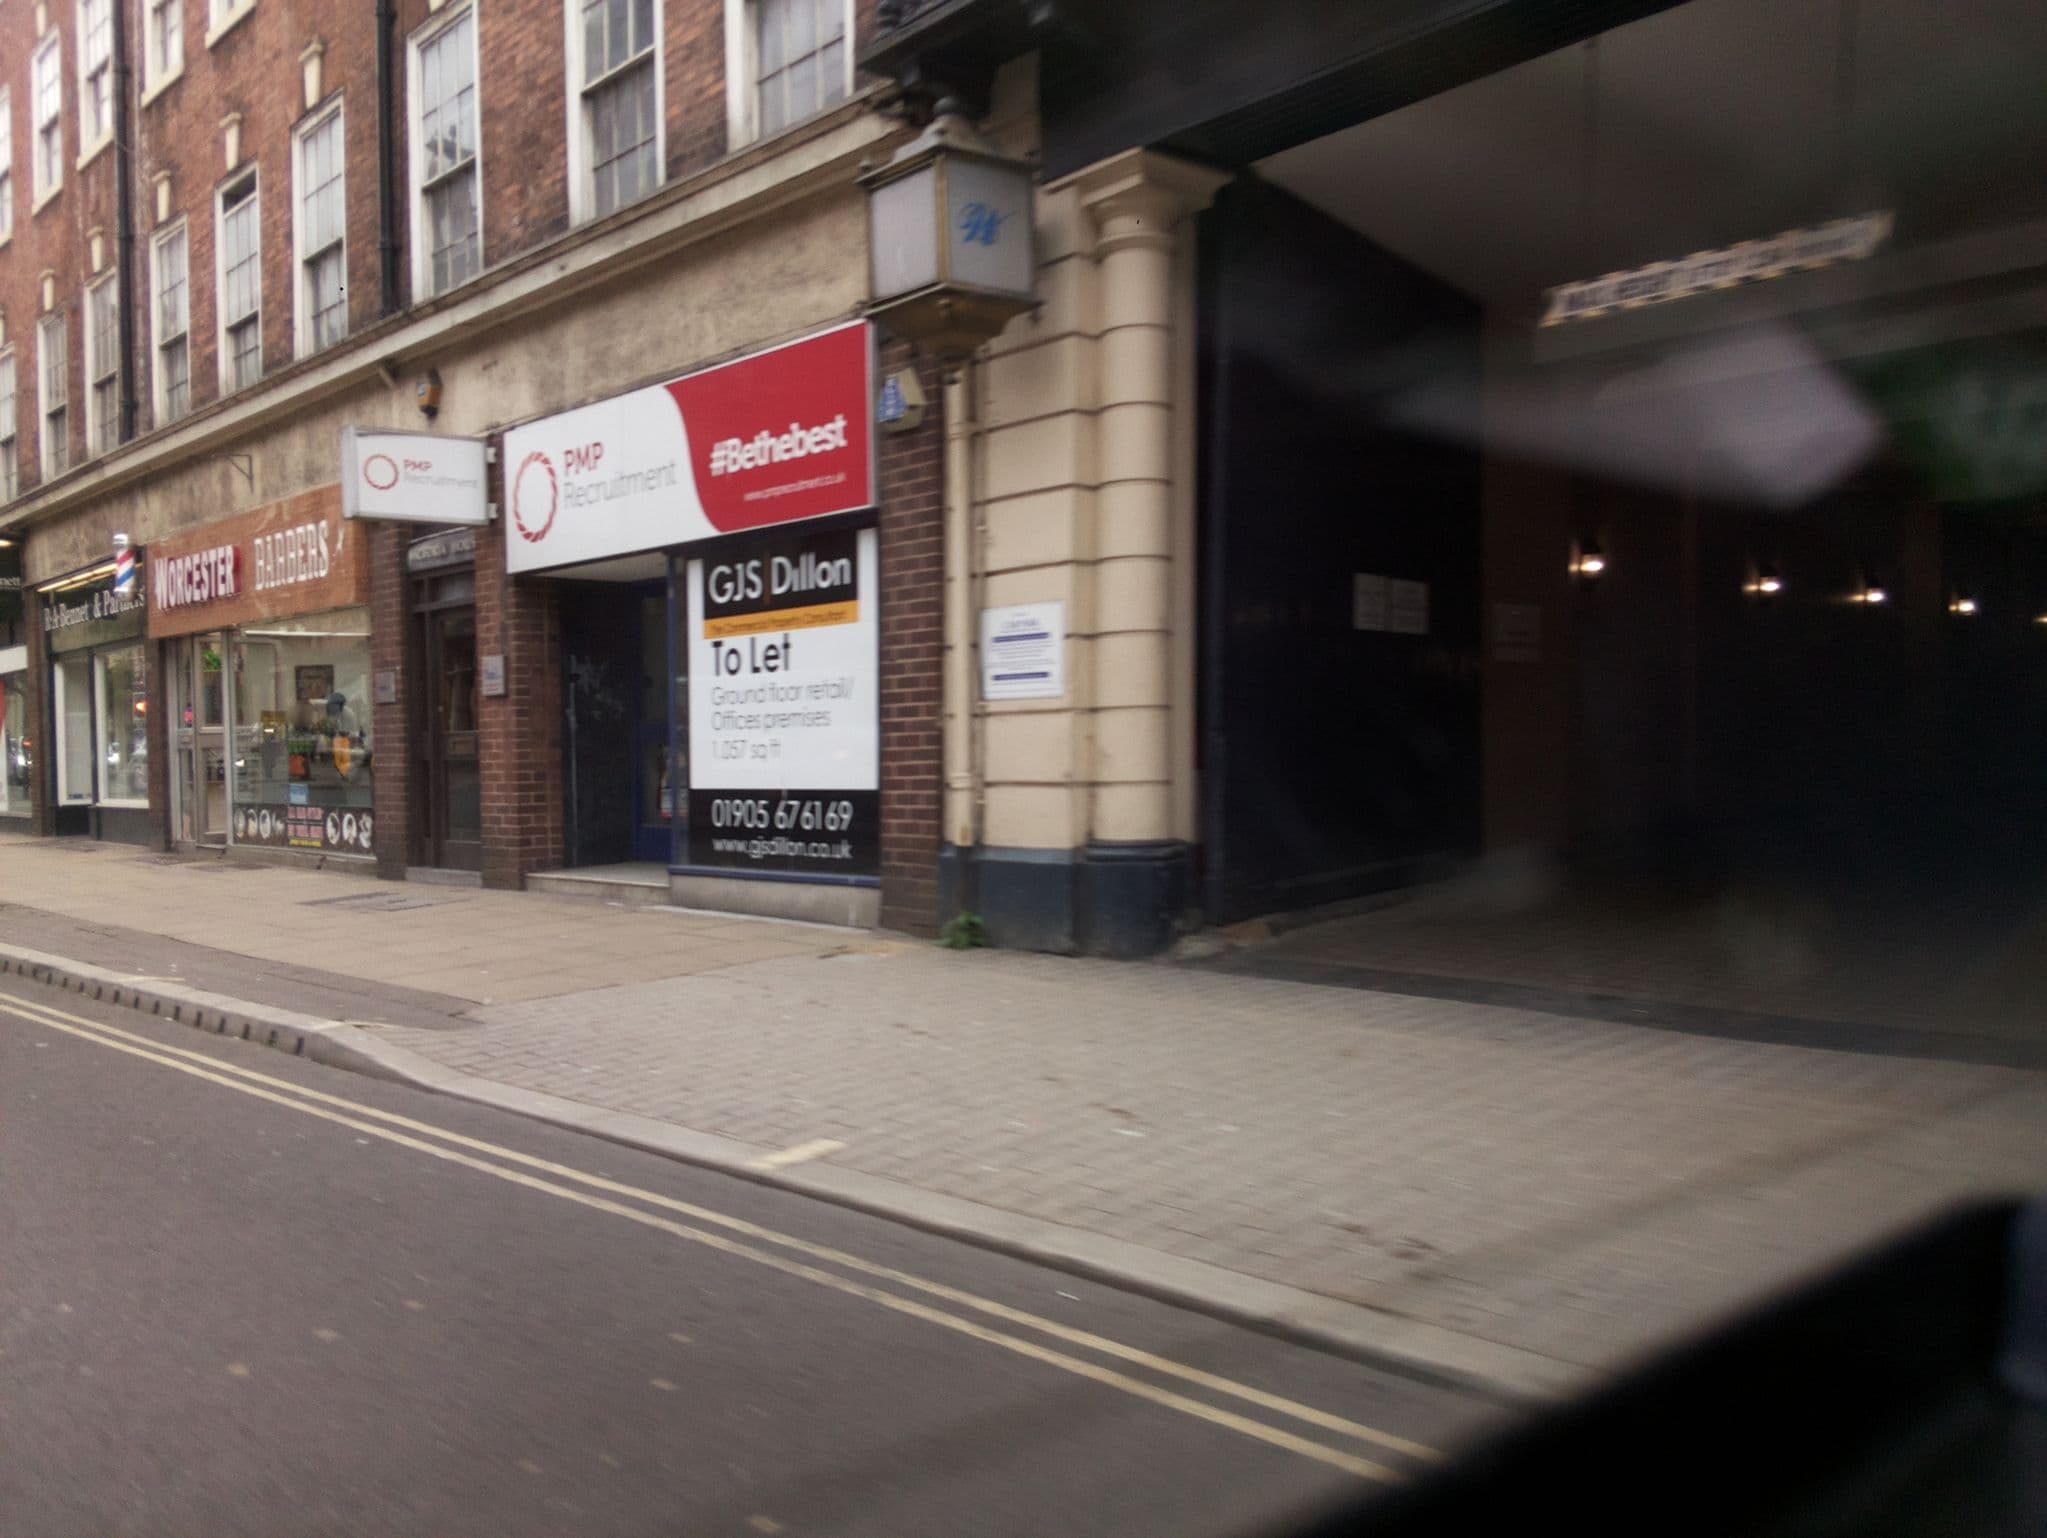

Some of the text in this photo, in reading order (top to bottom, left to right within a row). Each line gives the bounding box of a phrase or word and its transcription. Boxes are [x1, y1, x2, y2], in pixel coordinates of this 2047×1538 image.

[564, 441, 604, 476] PMP
[709, 413, 848, 477] #Bethebest
[155, 544, 236, 611] WORCESTER
[708, 552, 852, 604] GJS Dillon
[712, 632, 792, 676] To Let
[711, 799, 770, 829] 01905
